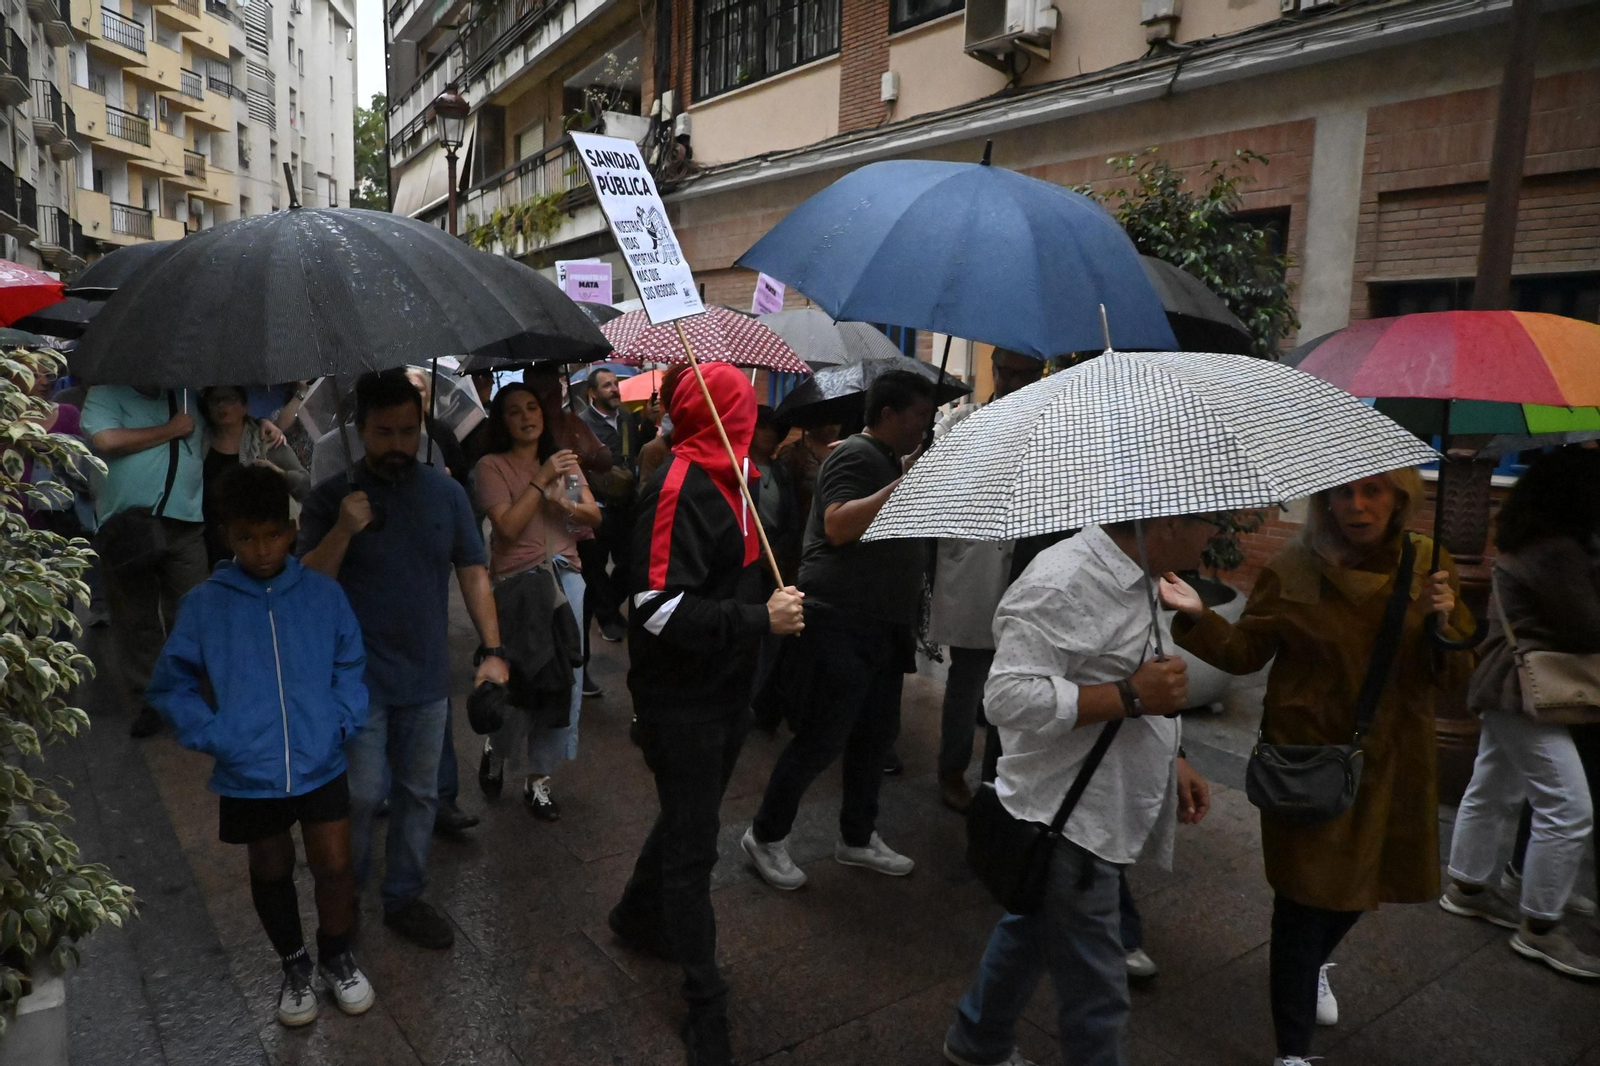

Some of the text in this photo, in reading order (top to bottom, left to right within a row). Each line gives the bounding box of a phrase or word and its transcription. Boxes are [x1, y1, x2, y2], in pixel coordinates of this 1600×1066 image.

[585, 149, 640, 170] SANIDAD
[596, 172, 653, 196] PÚBLICA
[614, 220, 643, 233] NUESTRAS
[621, 237, 640, 250] VIDAS
[629, 252, 659, 267] IMPORTAN
[636, 267, 662, 283] MÁS QUE
[643, 285, 658, 301] SUS
[653, 282, 679, 299] NEGOCIOS
